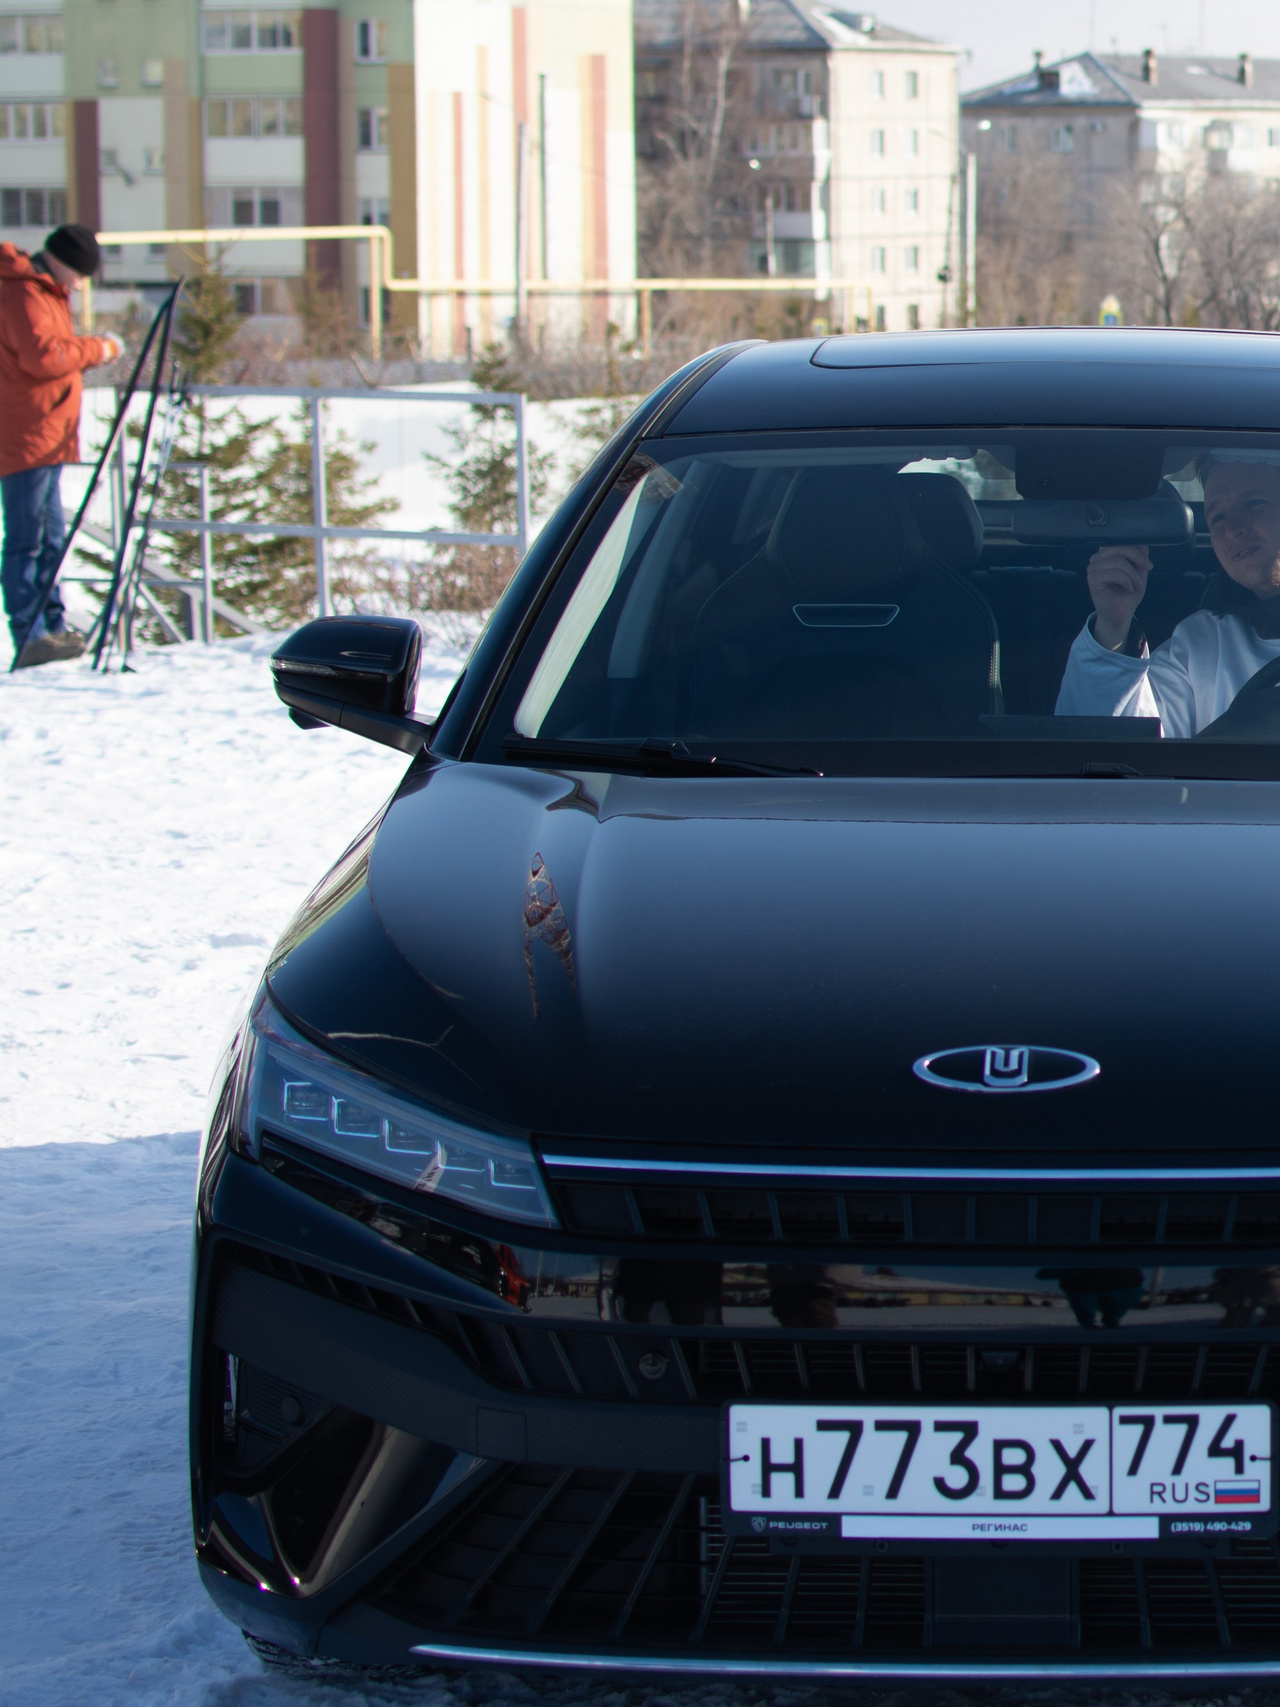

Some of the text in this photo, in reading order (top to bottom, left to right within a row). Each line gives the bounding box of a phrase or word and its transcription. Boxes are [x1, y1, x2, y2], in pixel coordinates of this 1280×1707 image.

[760, 1412, 1246, 1500] Н773ВХ 774
[1149, 1482, 1211, 1504] RUS
[769, 1521, 828, 1530] PEUGEOT
[972, 1523, 1028, 1532] РЕГИНАС
[1171, 1520, 1252, 1533] (3519) 490-429
